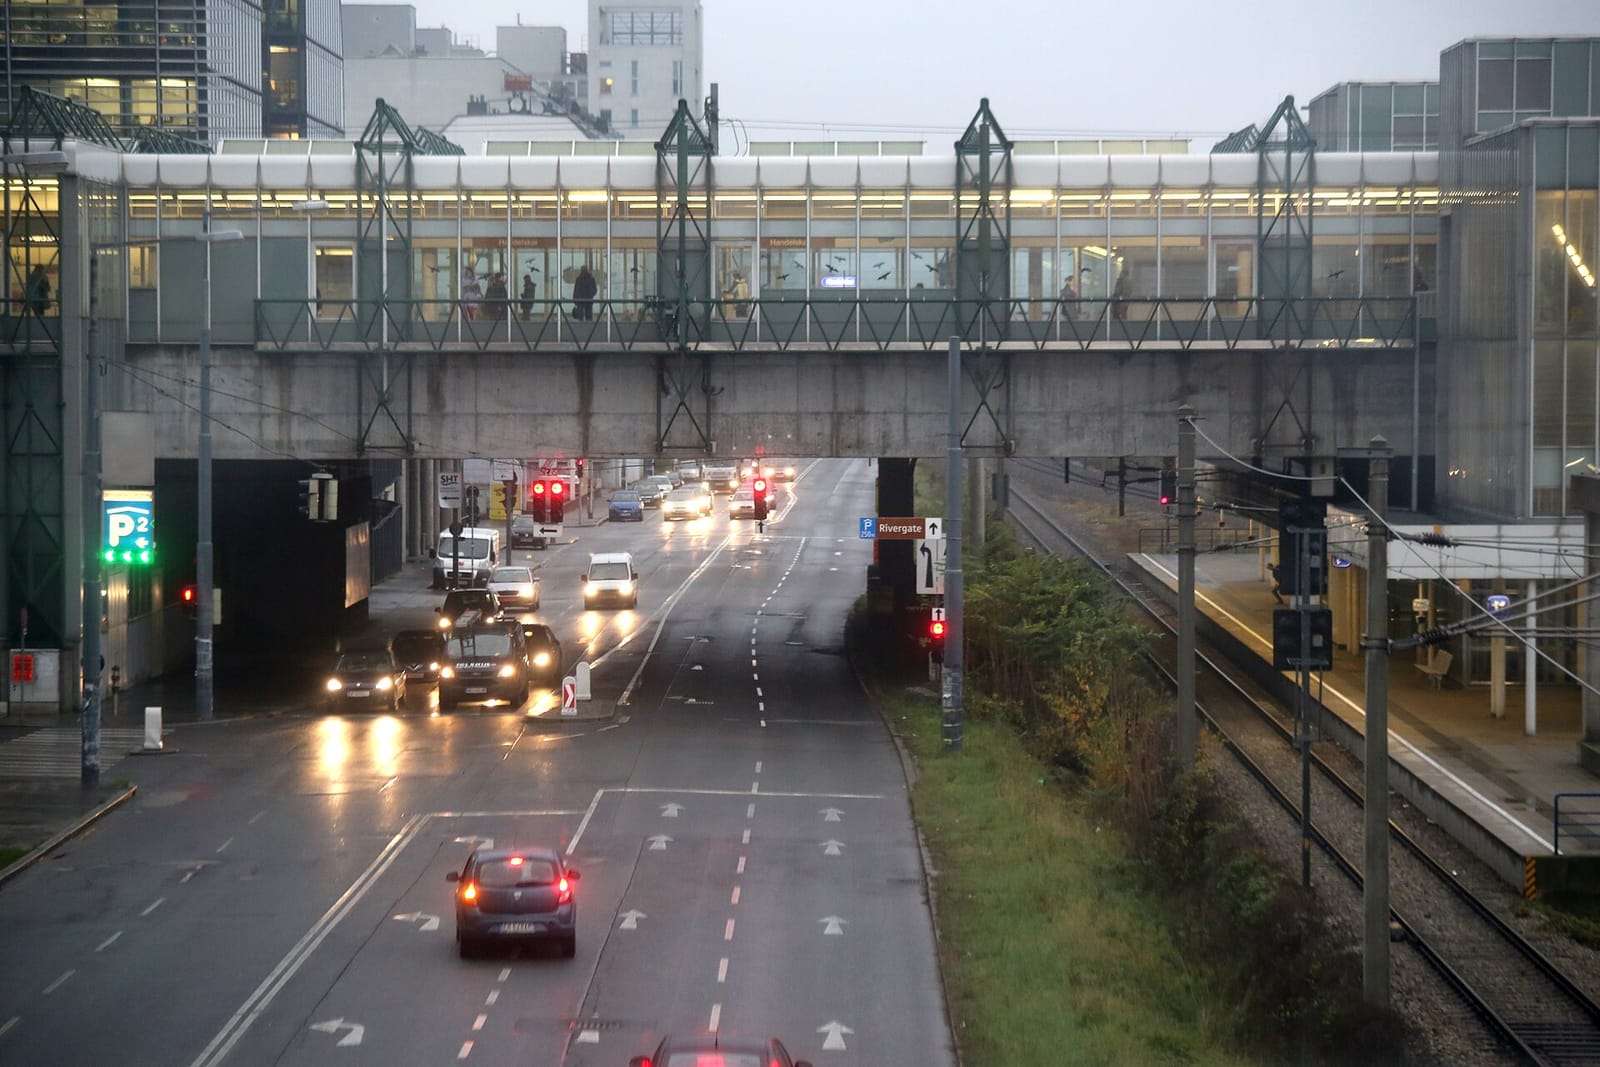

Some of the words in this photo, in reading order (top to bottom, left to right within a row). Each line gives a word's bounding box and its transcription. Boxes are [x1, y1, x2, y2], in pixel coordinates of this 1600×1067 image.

[440, 475, 458, 484] SHT
[109, 514, 135, 547] P
[137, 517, 149, 533] 2
[879, 524, 922, 535] Rivergate
